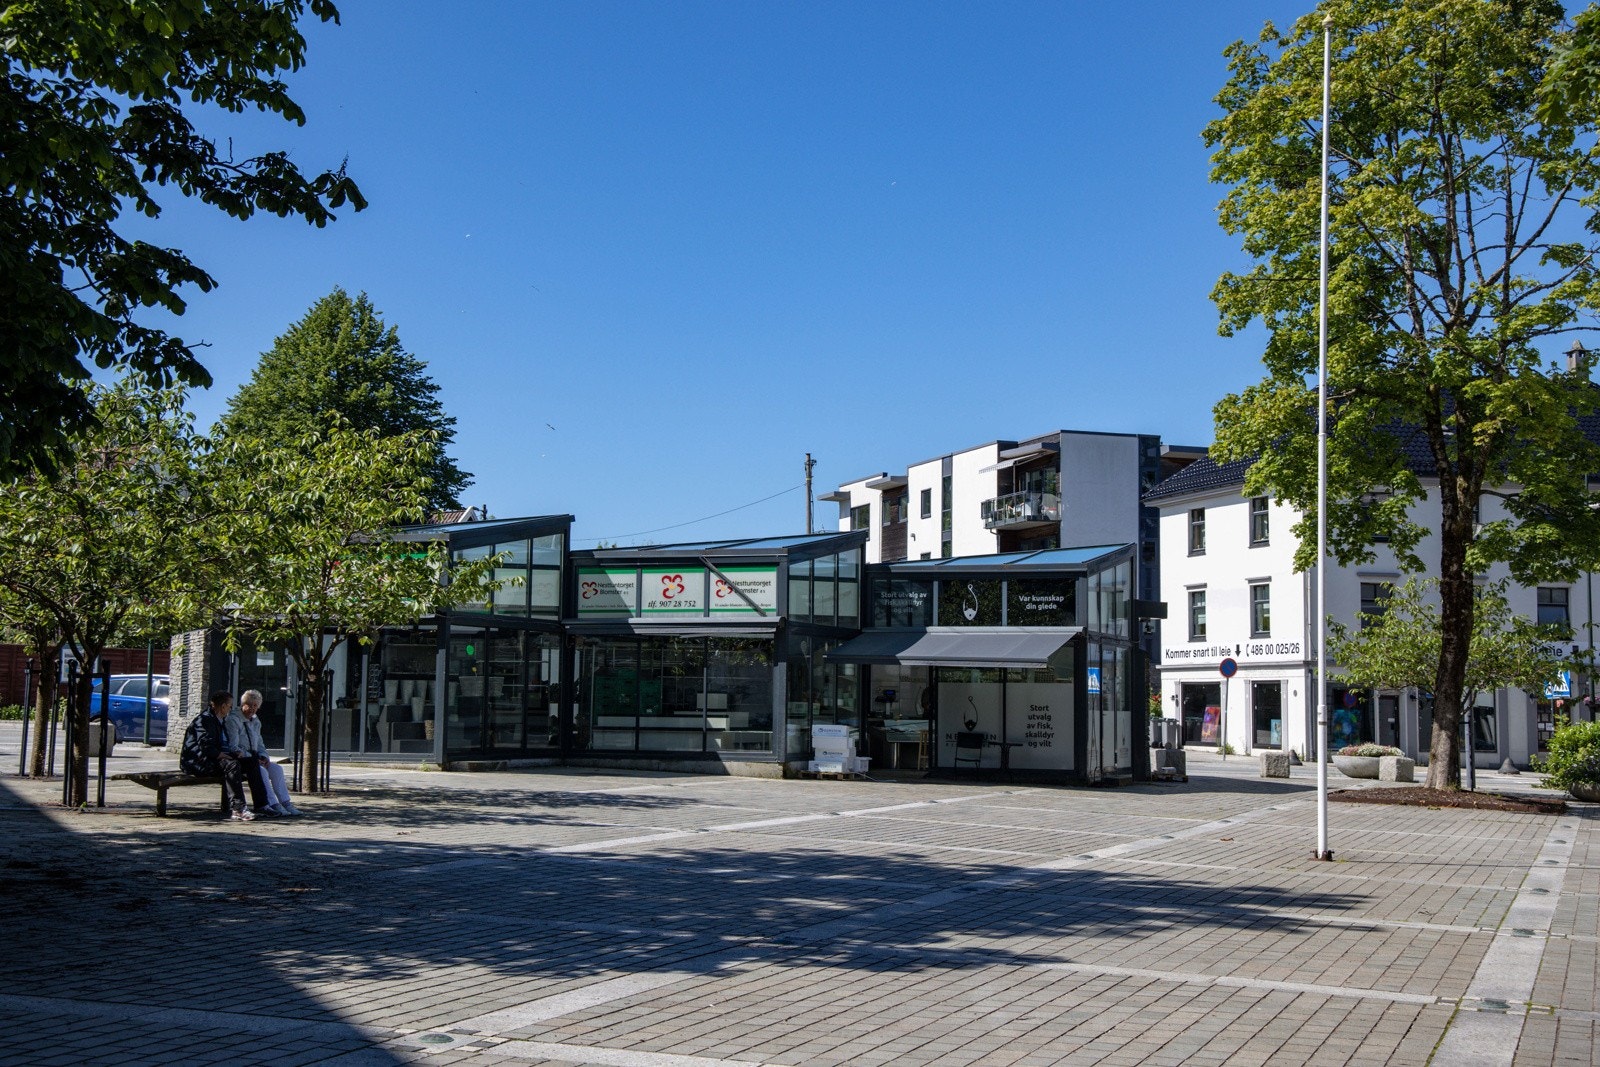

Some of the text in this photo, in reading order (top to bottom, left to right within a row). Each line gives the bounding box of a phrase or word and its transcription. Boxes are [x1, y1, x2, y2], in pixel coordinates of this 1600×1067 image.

[1031, 594, 1065, 603] kunnskap
[659, 600, 672, 608] 907
[673, 600, 682, 608] 28
[683, 600, 697, 608] 752
[1025, 602, 1058, 611] din glede
[1165, 649, 1192, 659] Kommer
[1193, 648, 1210, 658] snart
[1219, 646, 1231, 657] leie
[1250, 644, 1264, 656] 486
[1264, 644, 1274, 655] 00
[1275, 643, 1300, 655] 025/26
[1544, 645, 1563, 657] eie
[1030, 704, 1050, 712] Stort
[1027, 713, 1052, 722] utvalg
[1037, 721, 1053, 730] fisk,
[1025, 731, 1055, 740] skalldyr
[1039, 740, 1052, 748] vilt
